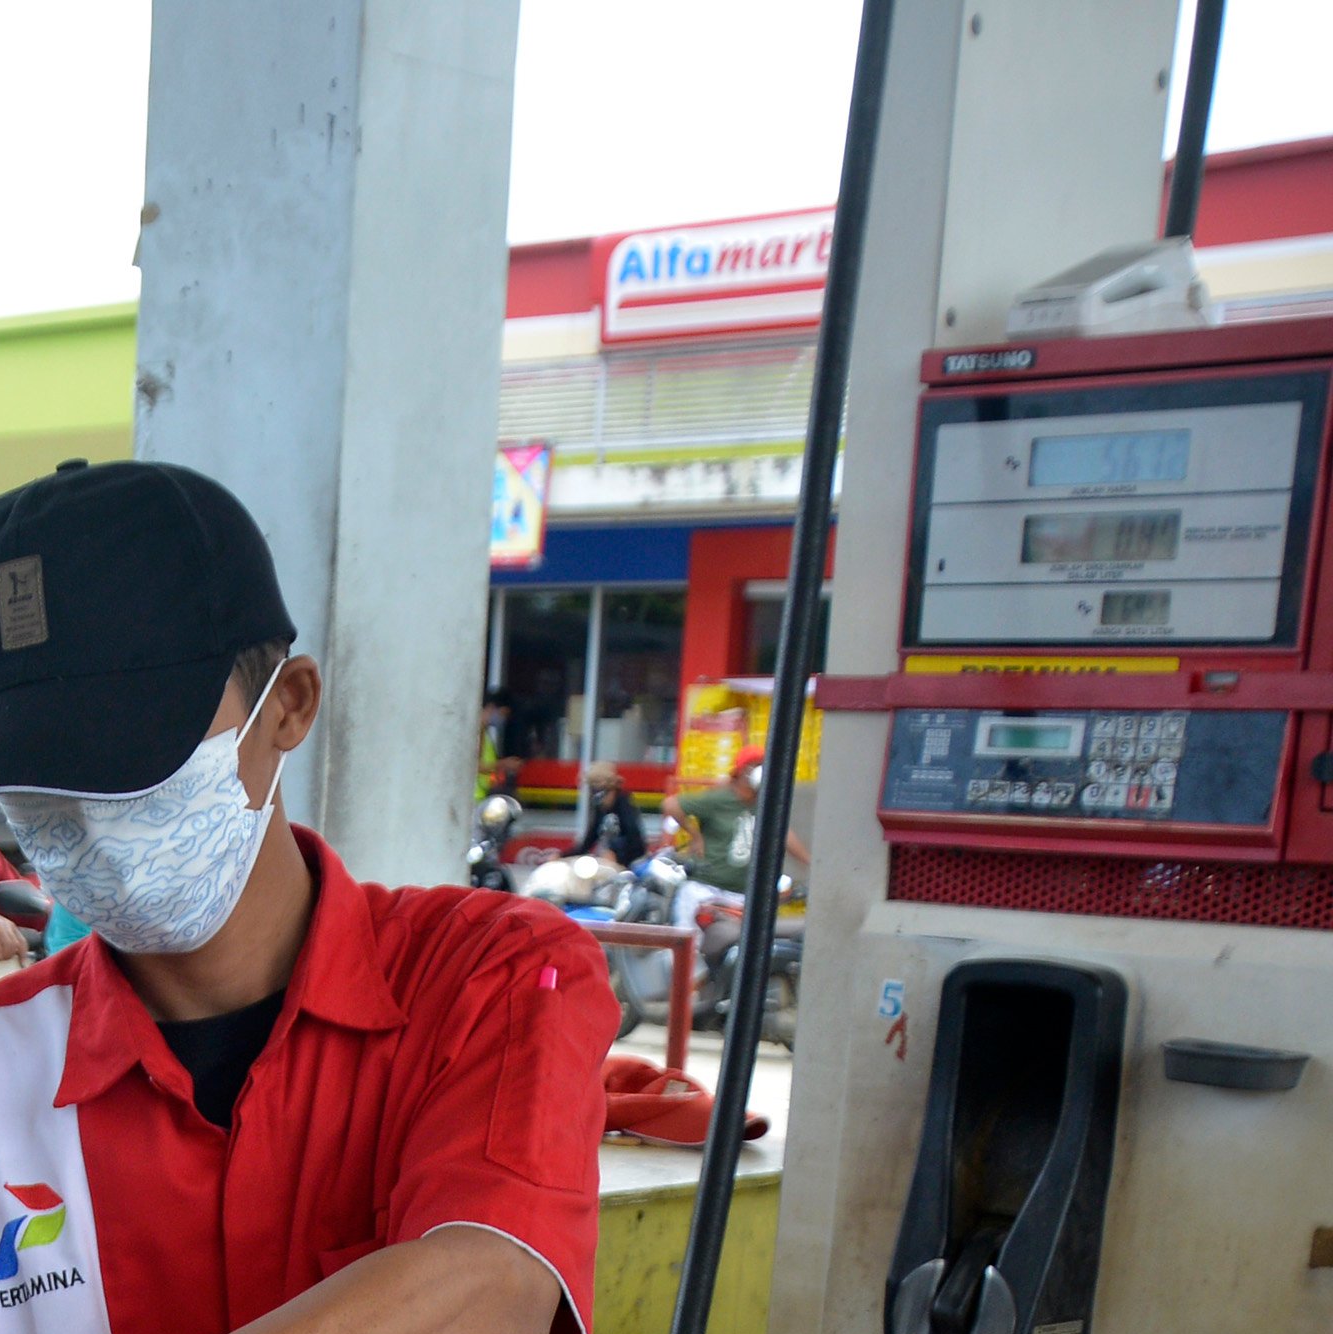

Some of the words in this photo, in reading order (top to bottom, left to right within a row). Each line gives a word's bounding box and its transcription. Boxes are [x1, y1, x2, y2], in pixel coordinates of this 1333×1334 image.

[619, 226, 832, 282] Alfamart
[947, 349, 1032, 373] TATSUNO
[879, 982, 903, 1017] 5
